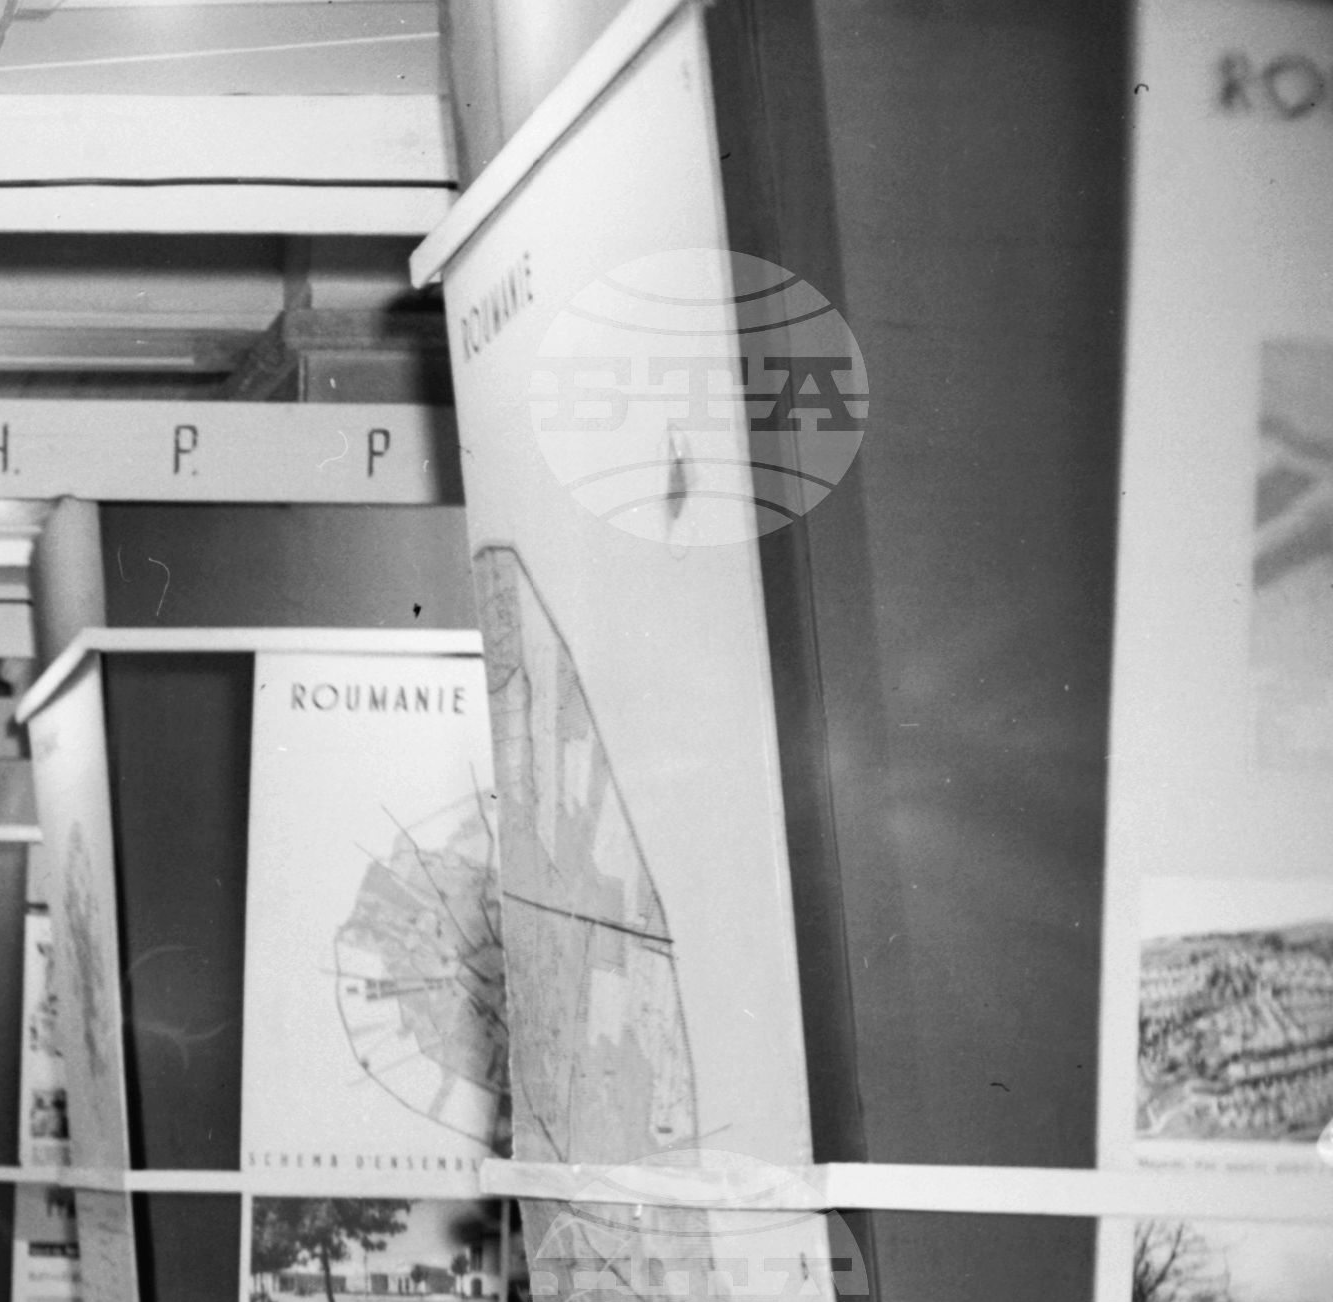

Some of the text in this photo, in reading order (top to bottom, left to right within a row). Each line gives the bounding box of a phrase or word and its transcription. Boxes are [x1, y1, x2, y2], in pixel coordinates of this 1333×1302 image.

[291, 683, 467, 716] ROUMANIE
[248, 1151, 481, 1173] SCHEMA D'ENSEMBL
